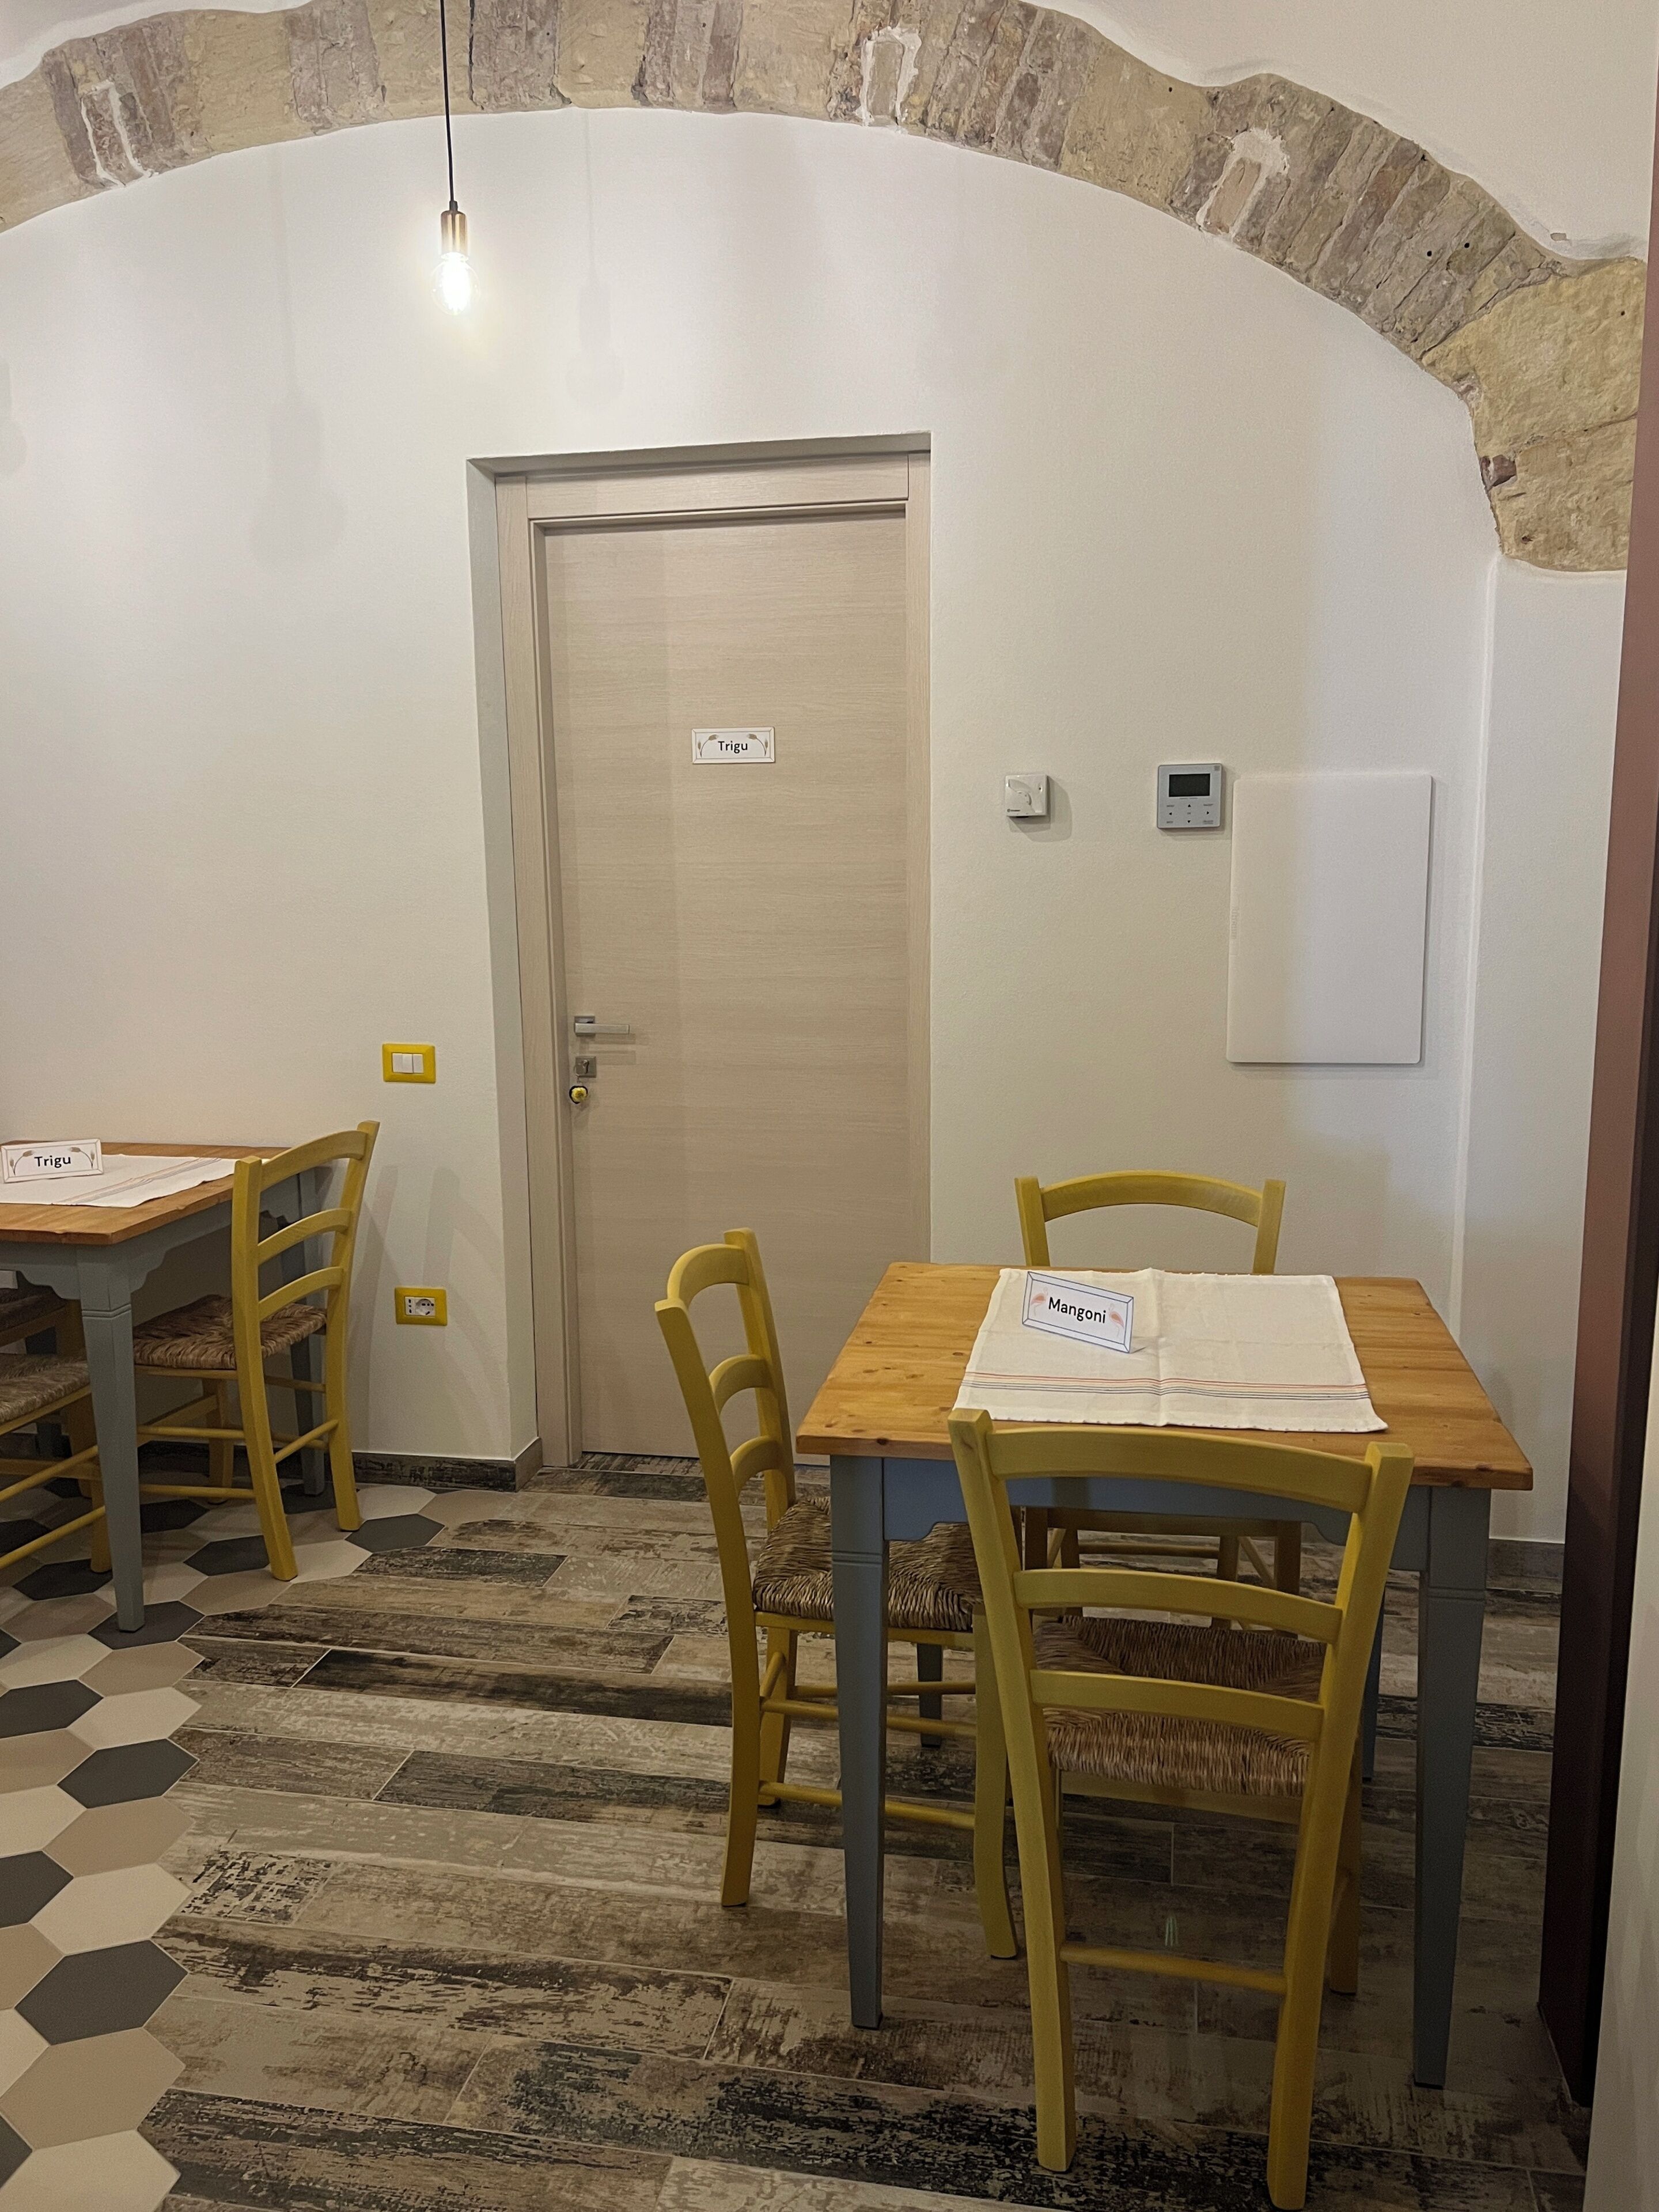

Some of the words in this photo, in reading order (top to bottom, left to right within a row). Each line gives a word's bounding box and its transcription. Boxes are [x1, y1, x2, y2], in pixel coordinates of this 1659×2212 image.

[718, 740, 748, 754] Trigu
[34, 1155, 71, 1168] Trigu
[1048, 1297, 1106, 1323] Mangoni
